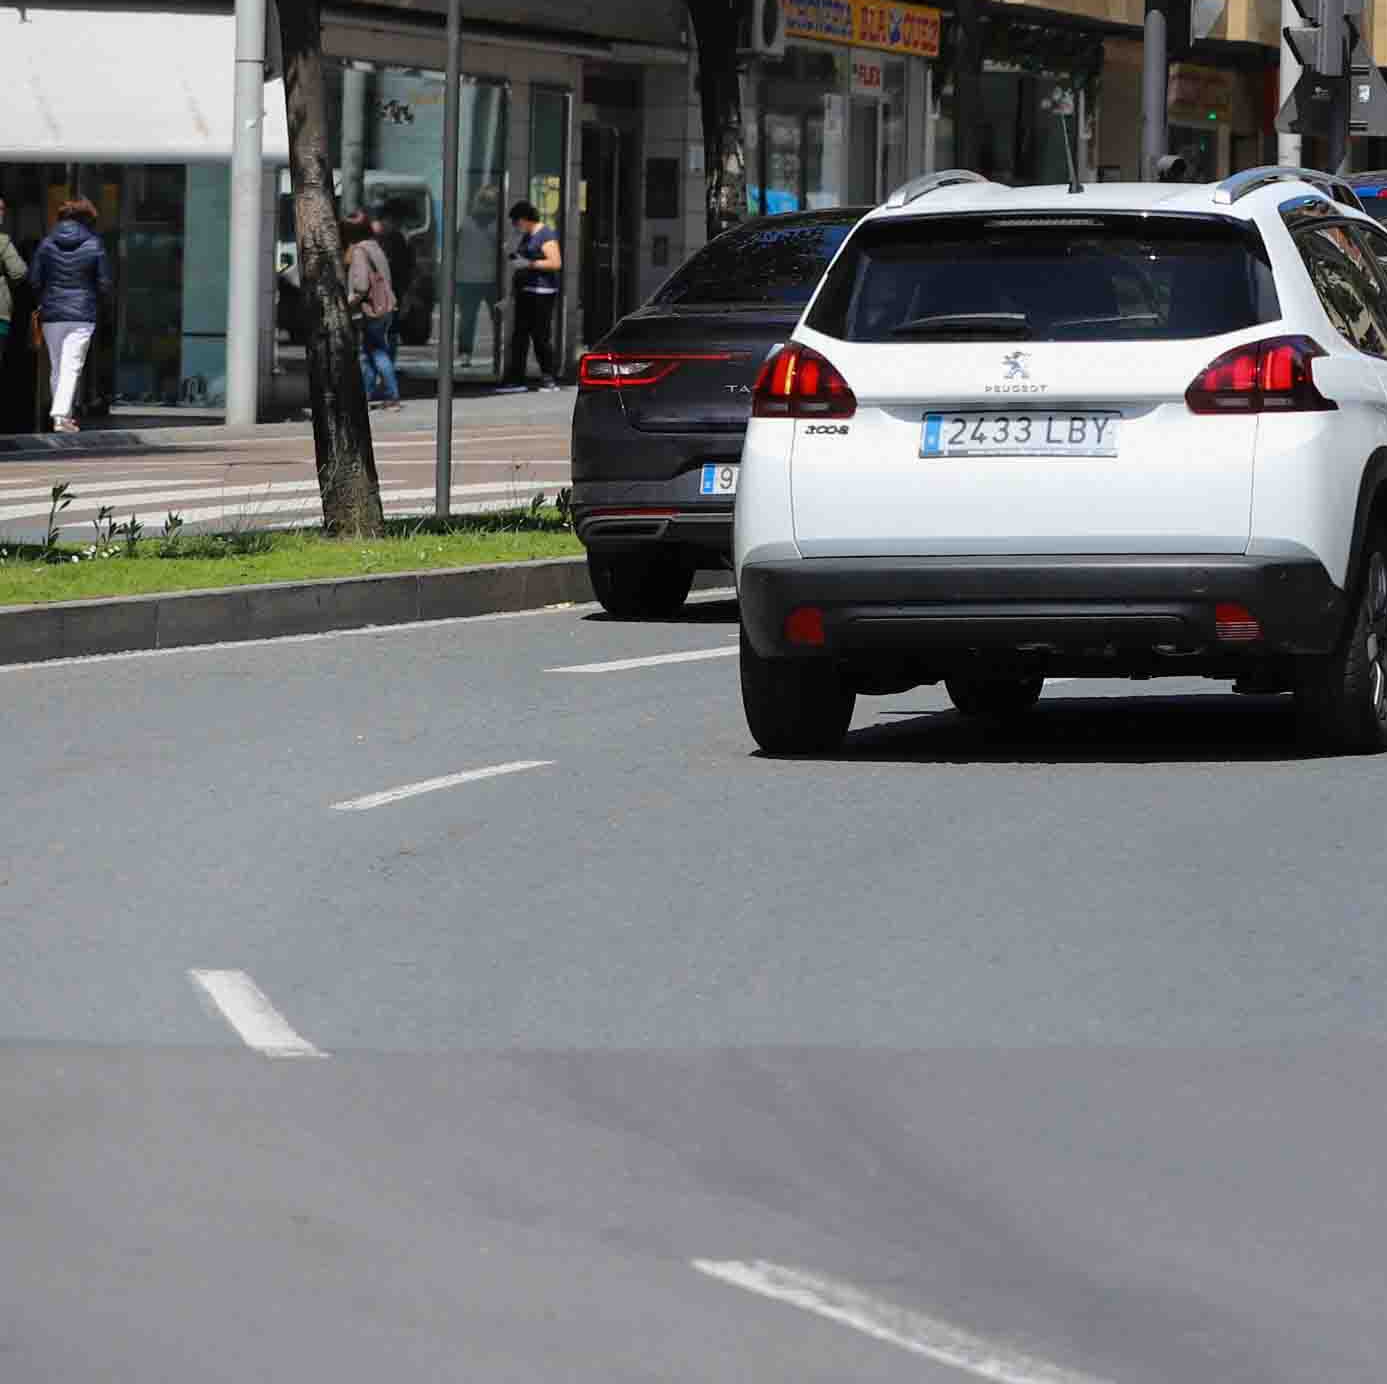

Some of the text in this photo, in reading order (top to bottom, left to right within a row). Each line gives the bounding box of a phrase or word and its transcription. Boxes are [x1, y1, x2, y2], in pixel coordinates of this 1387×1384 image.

[724, 383, 751, 393] TA
[984, 384, 1048, 393] PEUGEOT
[947, 415, 1110, 446] 2433 LBY
